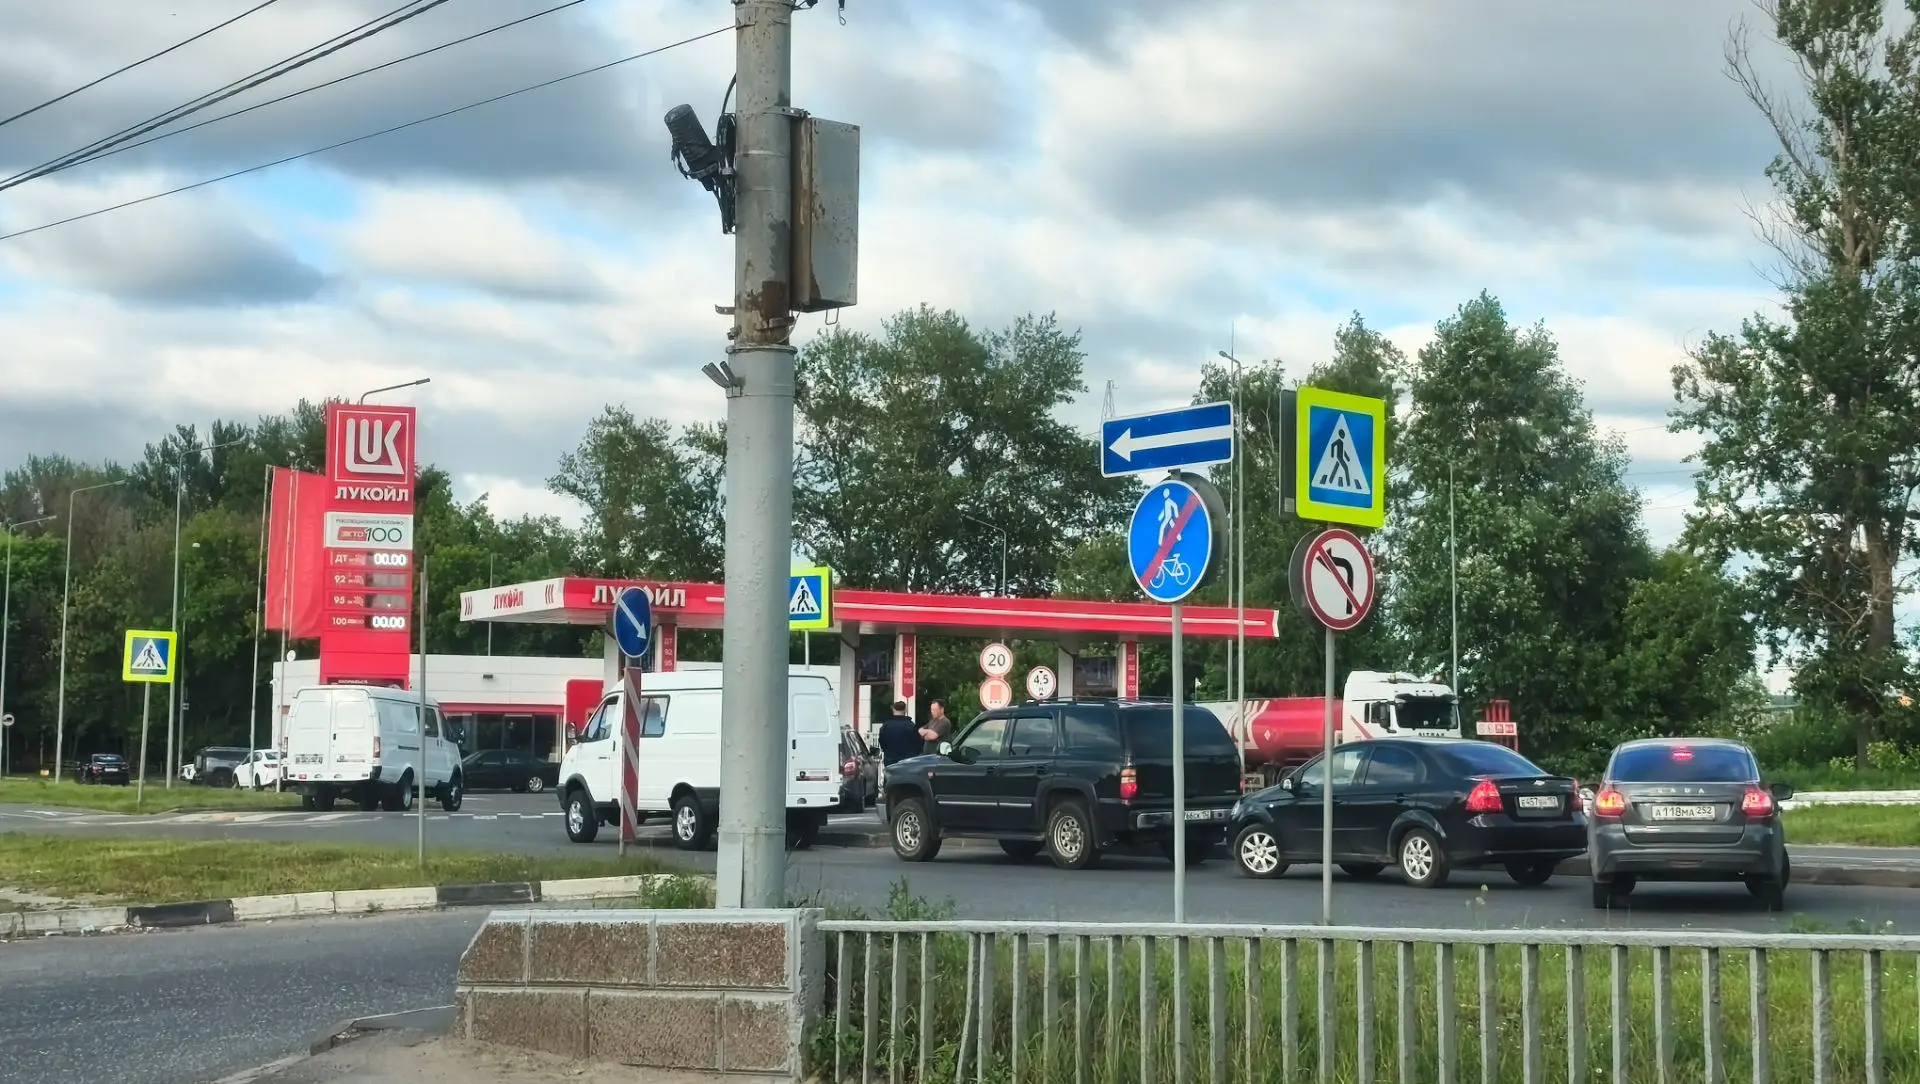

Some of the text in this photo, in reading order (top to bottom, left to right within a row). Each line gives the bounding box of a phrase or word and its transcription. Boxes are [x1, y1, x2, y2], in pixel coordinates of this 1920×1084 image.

[335, 485, 409, 502] ЛУКОЙЛ
[365, 527, 403, 543] 100
[334, 554, 348, 563] ДТ
[373, 553, 407, 566] 00.00
[334, 575, 346, 583] 92
[333, 596, 345, 605] 95
[493, 587, 524, 610] ЛУКОЙЛ
[332, 616, 347, 625] 100
[372, 616, 405, 628] 00.00
[988, 653, 1006, 667] 20
[1655, 806, 1712, 817] А118МА 252
